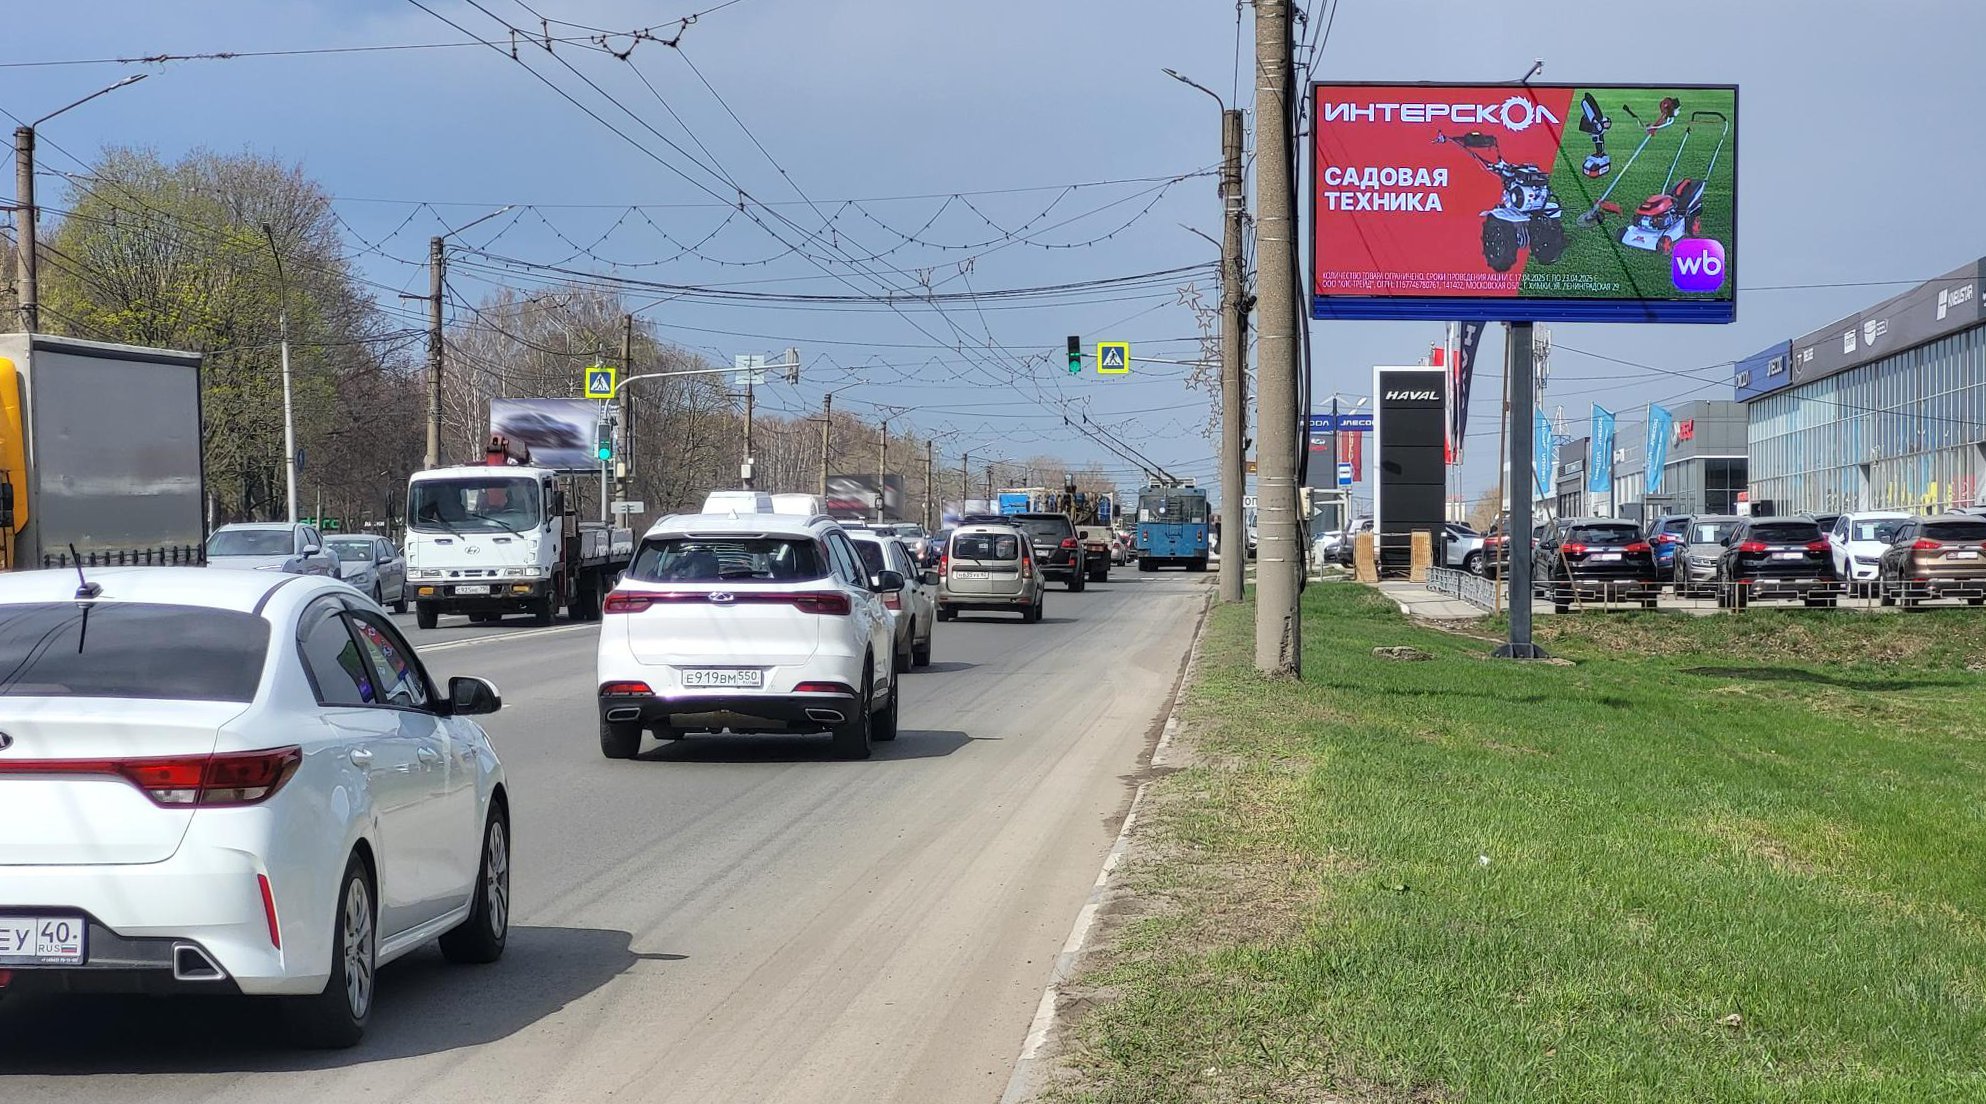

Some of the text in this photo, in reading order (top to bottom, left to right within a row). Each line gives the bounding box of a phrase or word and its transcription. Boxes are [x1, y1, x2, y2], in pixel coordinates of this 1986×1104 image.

[1324, 95, 1560, 132] ИНТЕРСКОЛ
[1324, 167, 1448, 190] САДОВАЯ
[1324, 192, 1443, 212] ТЕХНИКА
[1676, 249, 1722, 276] wb
[1385, 390, 1440, 400] HAVAL
[686, 671, 757, 684] Е919ВМ 550
[38, 944, 61, 953] RUS
